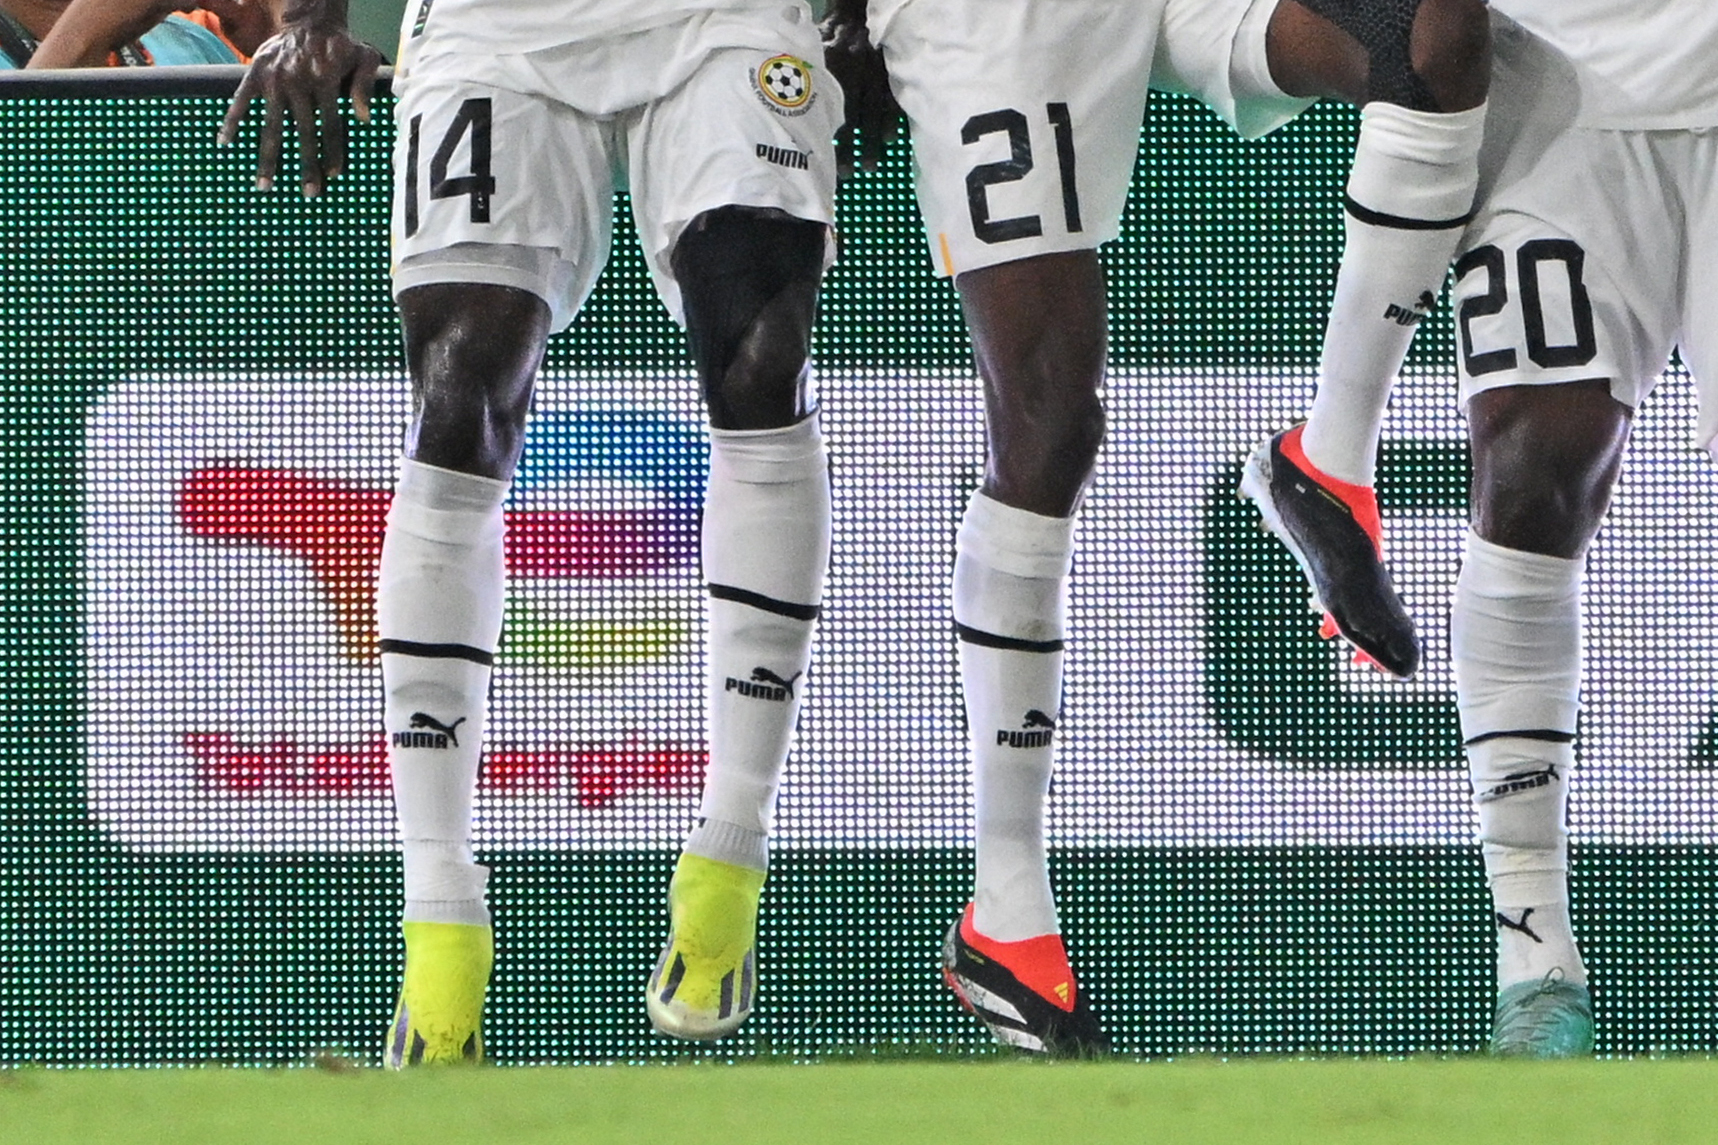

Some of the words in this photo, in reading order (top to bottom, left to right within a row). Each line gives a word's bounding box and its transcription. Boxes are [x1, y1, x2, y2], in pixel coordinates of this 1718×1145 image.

[405, 97, 495, 239] 14
[756, 143, 809, 171] PUMA
[961, 102, 1083, 245] 21
[1453, 238, 1597, 378] 20
[725, 677, 787, 702] PUMA
[392, 731, 448, 749] PUMA
[997, 729, 1053, 749] PUMA
